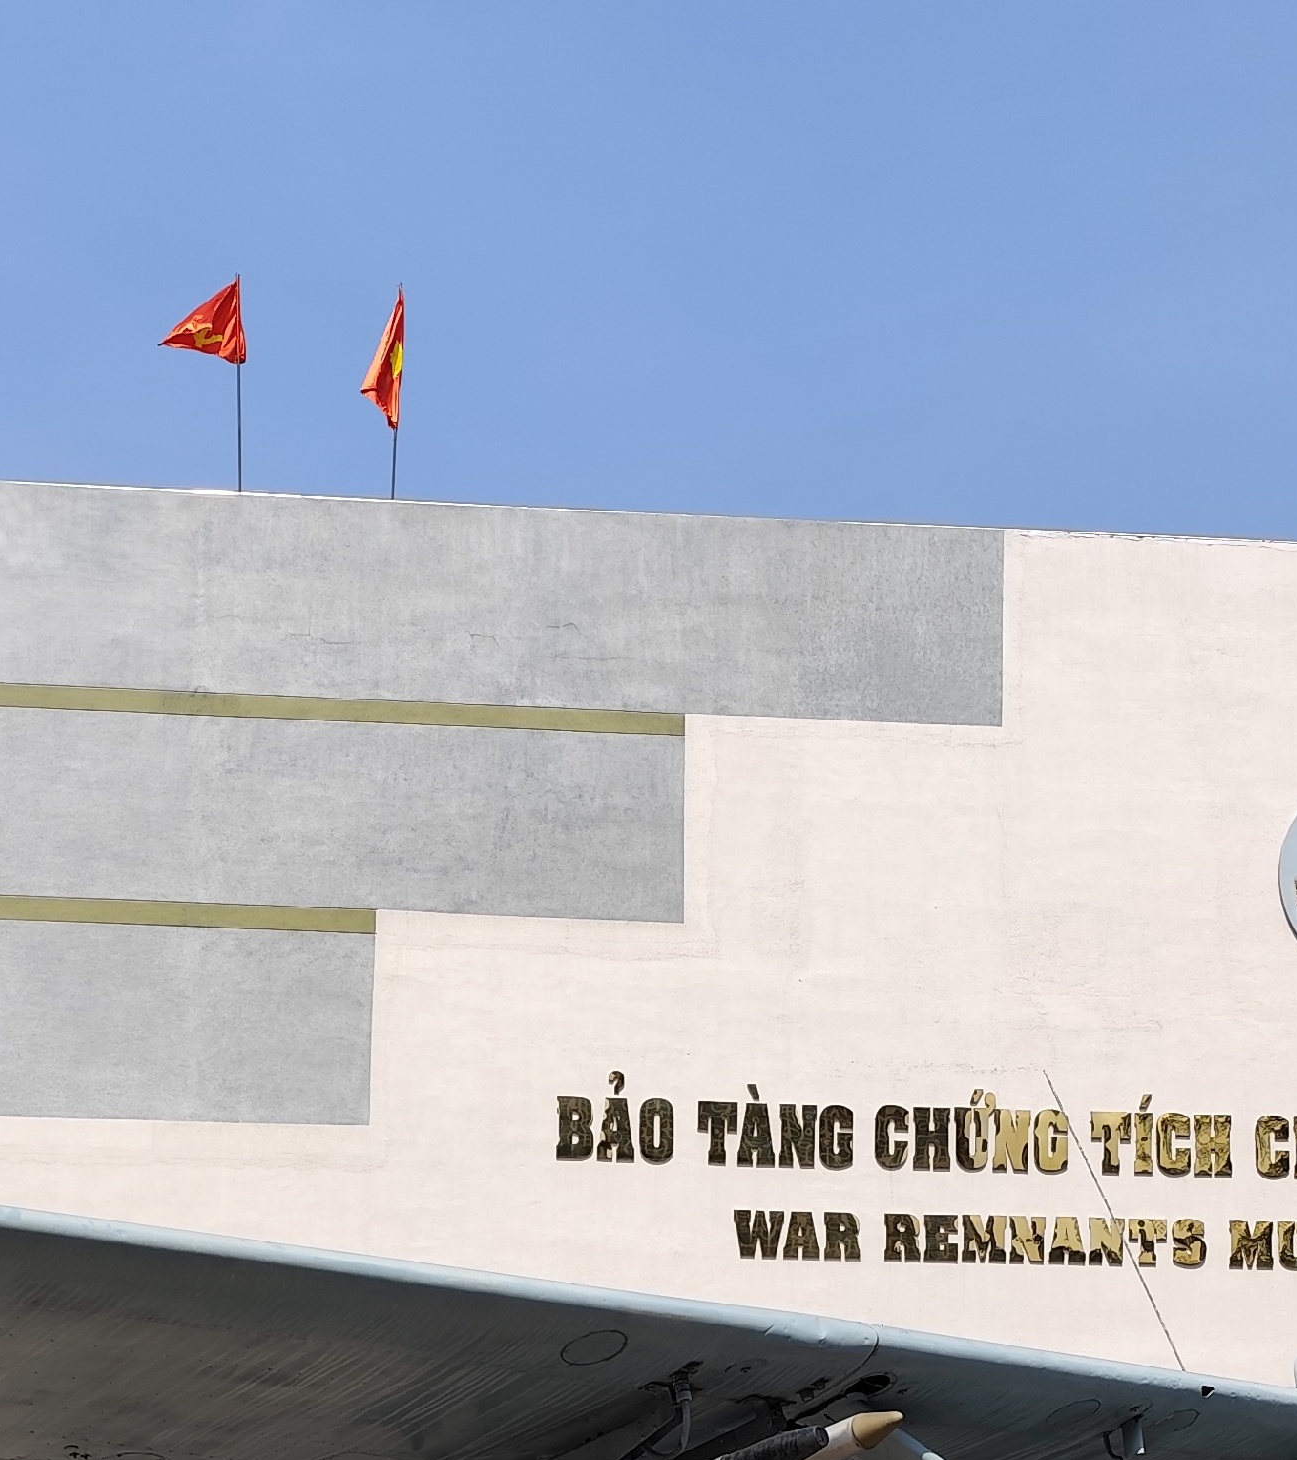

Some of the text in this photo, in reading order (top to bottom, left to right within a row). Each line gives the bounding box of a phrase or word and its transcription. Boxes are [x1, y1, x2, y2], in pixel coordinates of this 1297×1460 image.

[555, 1071, 675, 1166] BẢO
[696, 1084, 855, 1171] TÀNG
[874, 1088, 1069, 1175] CHỨNG
[1089, 1094, 1234, 1178] TÍCH
[733, 1209, 862, 1263] WAR
[883, 1213, 1207, 1269] REMNANTS
